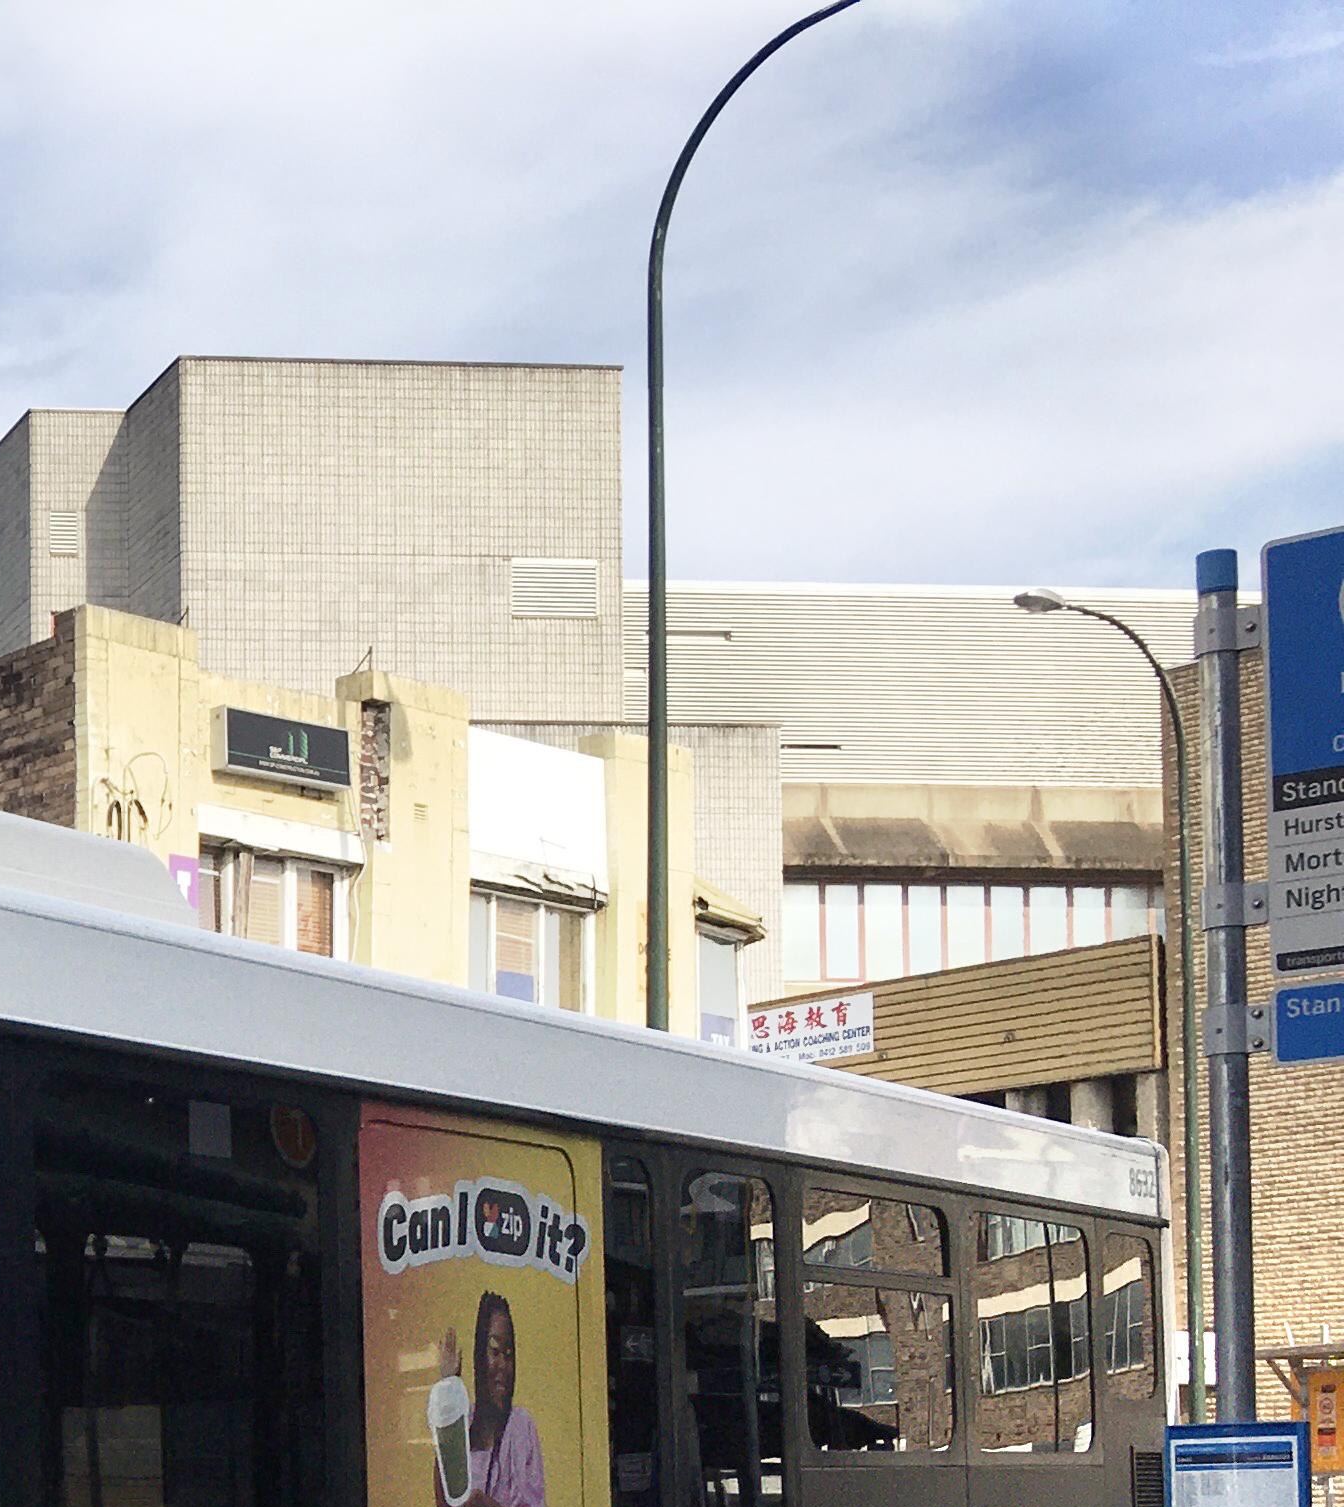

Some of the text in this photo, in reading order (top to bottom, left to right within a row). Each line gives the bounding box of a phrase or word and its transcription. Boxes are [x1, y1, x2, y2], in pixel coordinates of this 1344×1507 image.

[774, 1037, 801, 1051] ACTION
[803, 1031, 840, 1047] COACHING
[842, 1025, 872, 1040] CENTER
[383, 1191, 587, 1275] Can I zip it?
